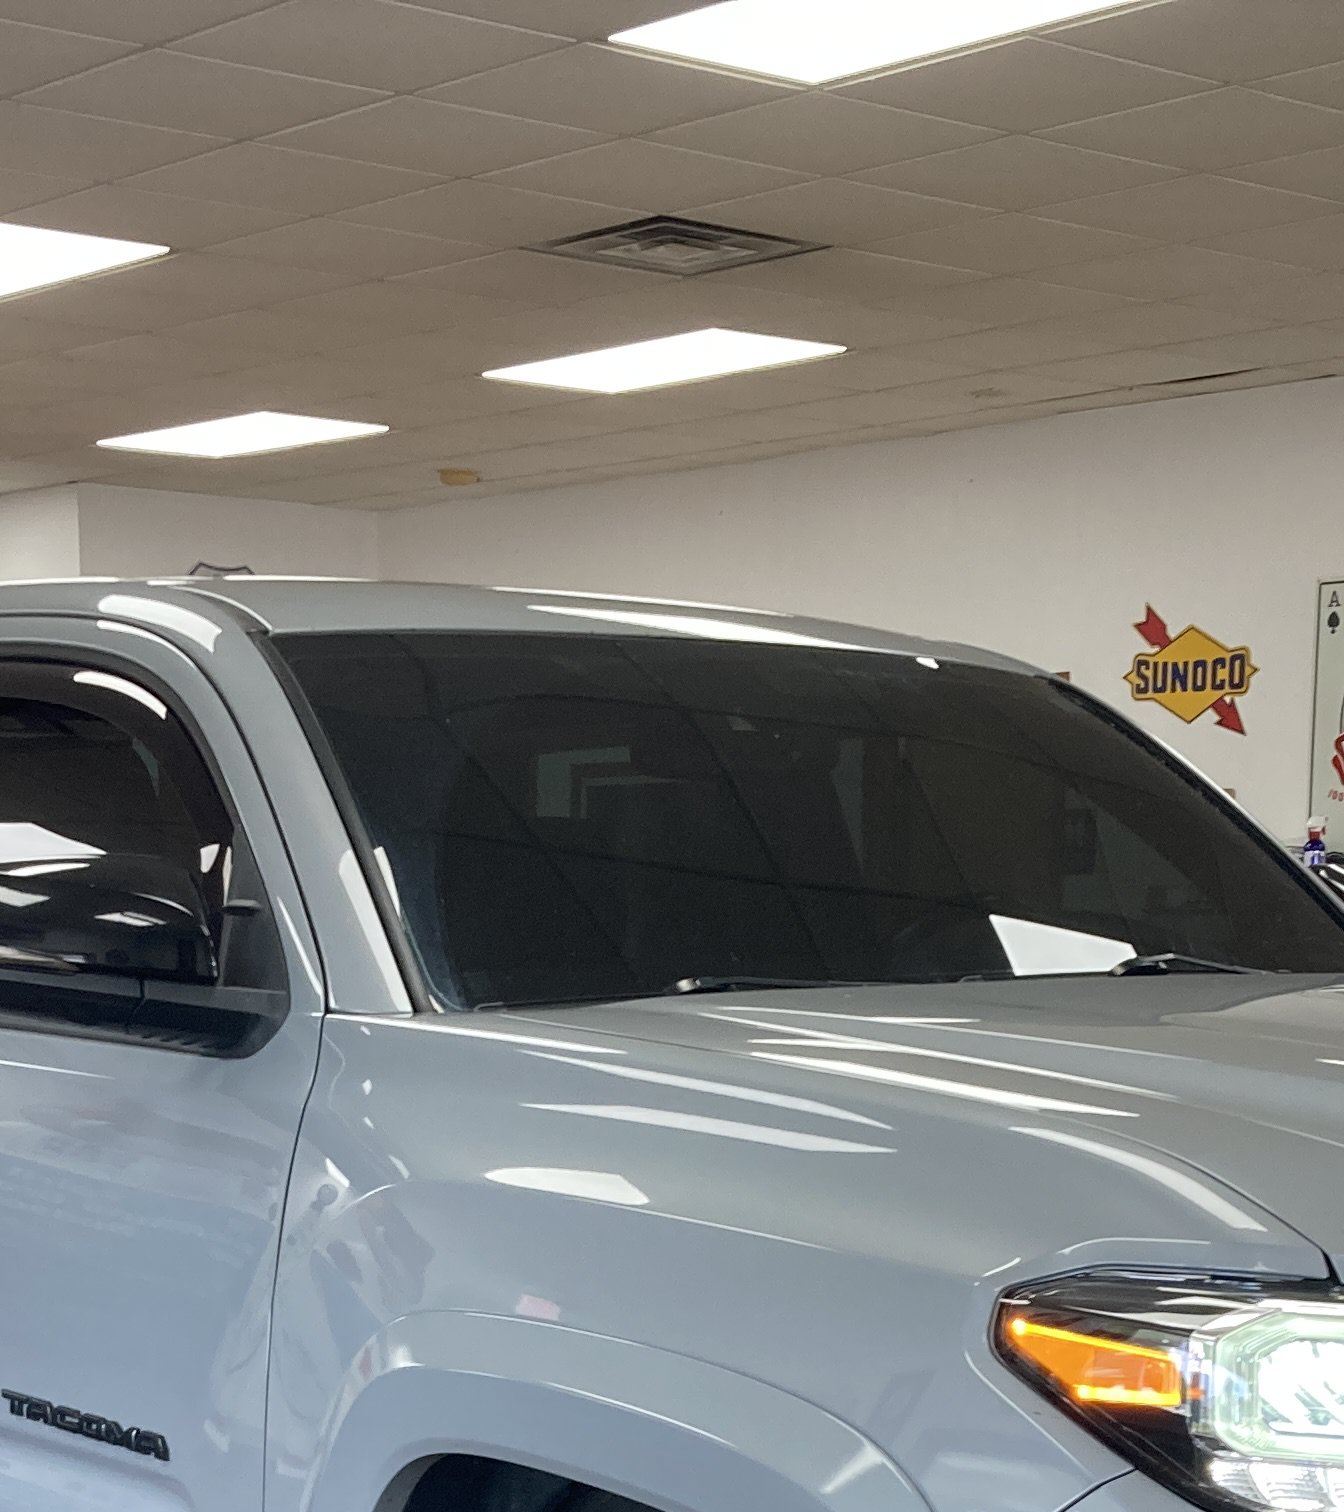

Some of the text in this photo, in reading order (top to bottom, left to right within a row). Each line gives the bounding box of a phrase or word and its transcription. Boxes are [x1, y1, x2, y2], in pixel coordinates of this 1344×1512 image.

[1328, 591, 1341, 607] A
[1135, 653, 1246, 694] SUNOCO
[1, 1388, 170, 1461] TACOMA
